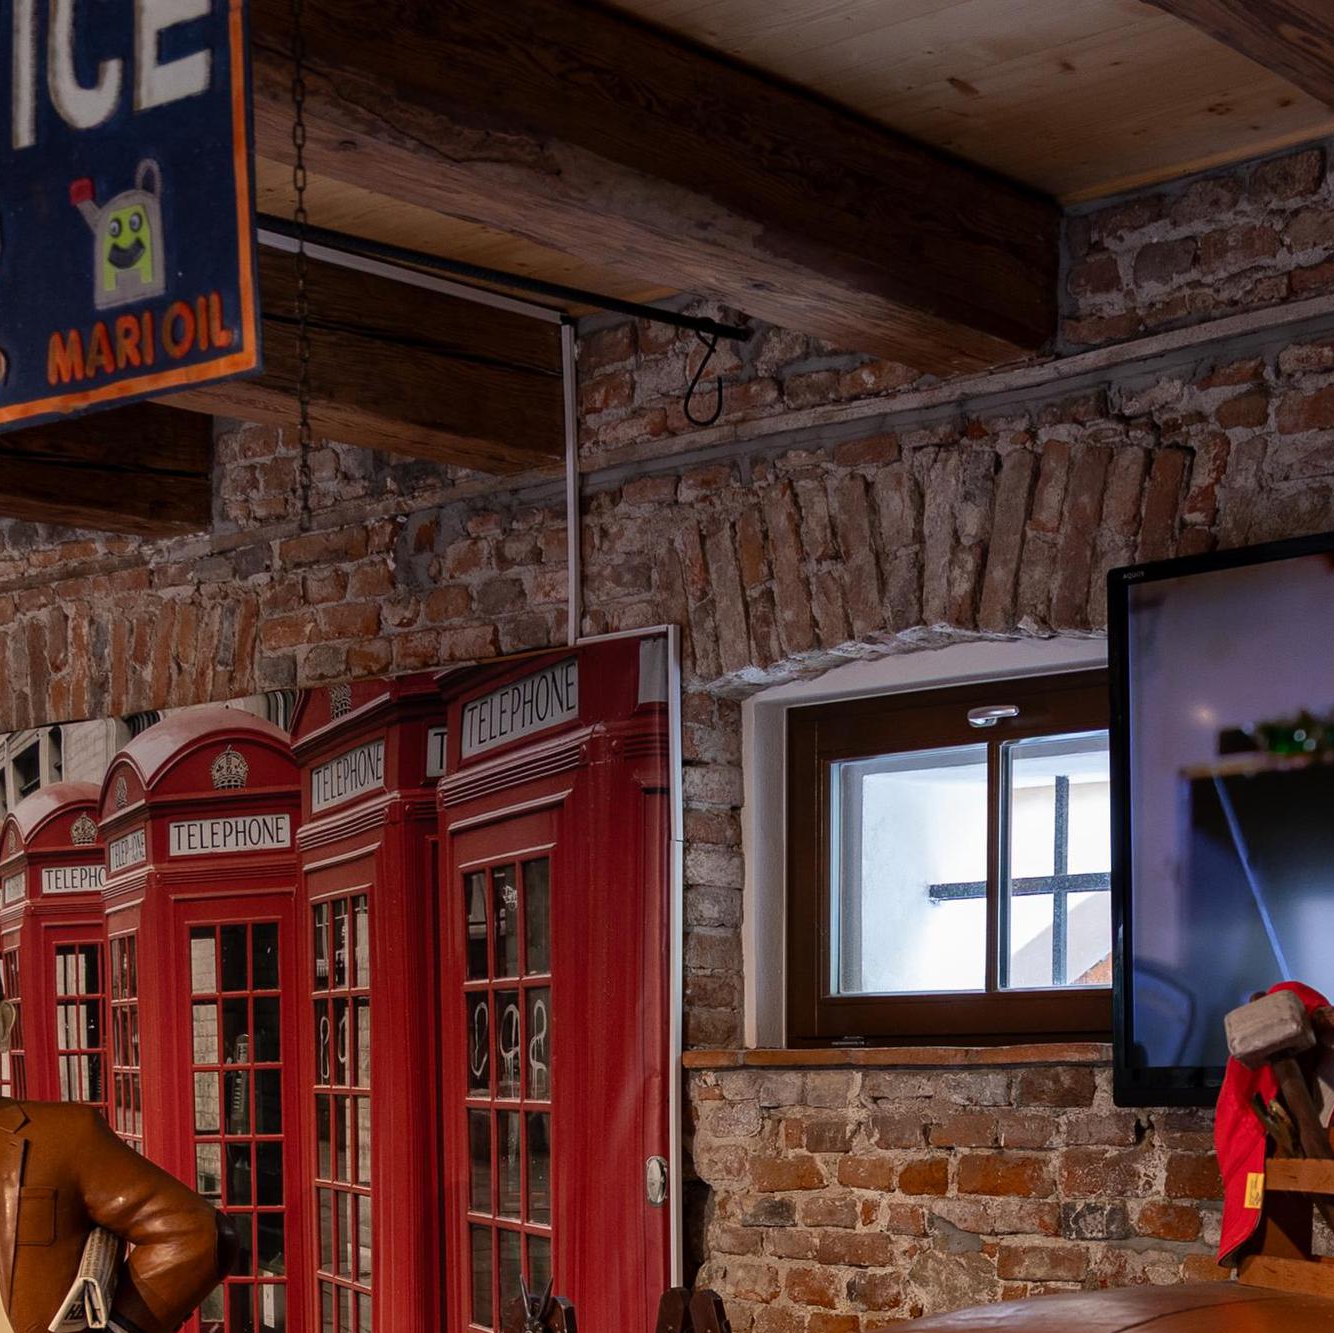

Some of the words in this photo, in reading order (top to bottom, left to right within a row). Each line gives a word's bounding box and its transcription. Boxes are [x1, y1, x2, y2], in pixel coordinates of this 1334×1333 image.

[47, 310, 154, 385] MARI
[162, 290, 232, 359] OIL
[468, 662, 576, 748] TELEPHONE
[314, 743, 383, 805] TELEPHONE
[173, 816, 285, 850] TELEPHONE
